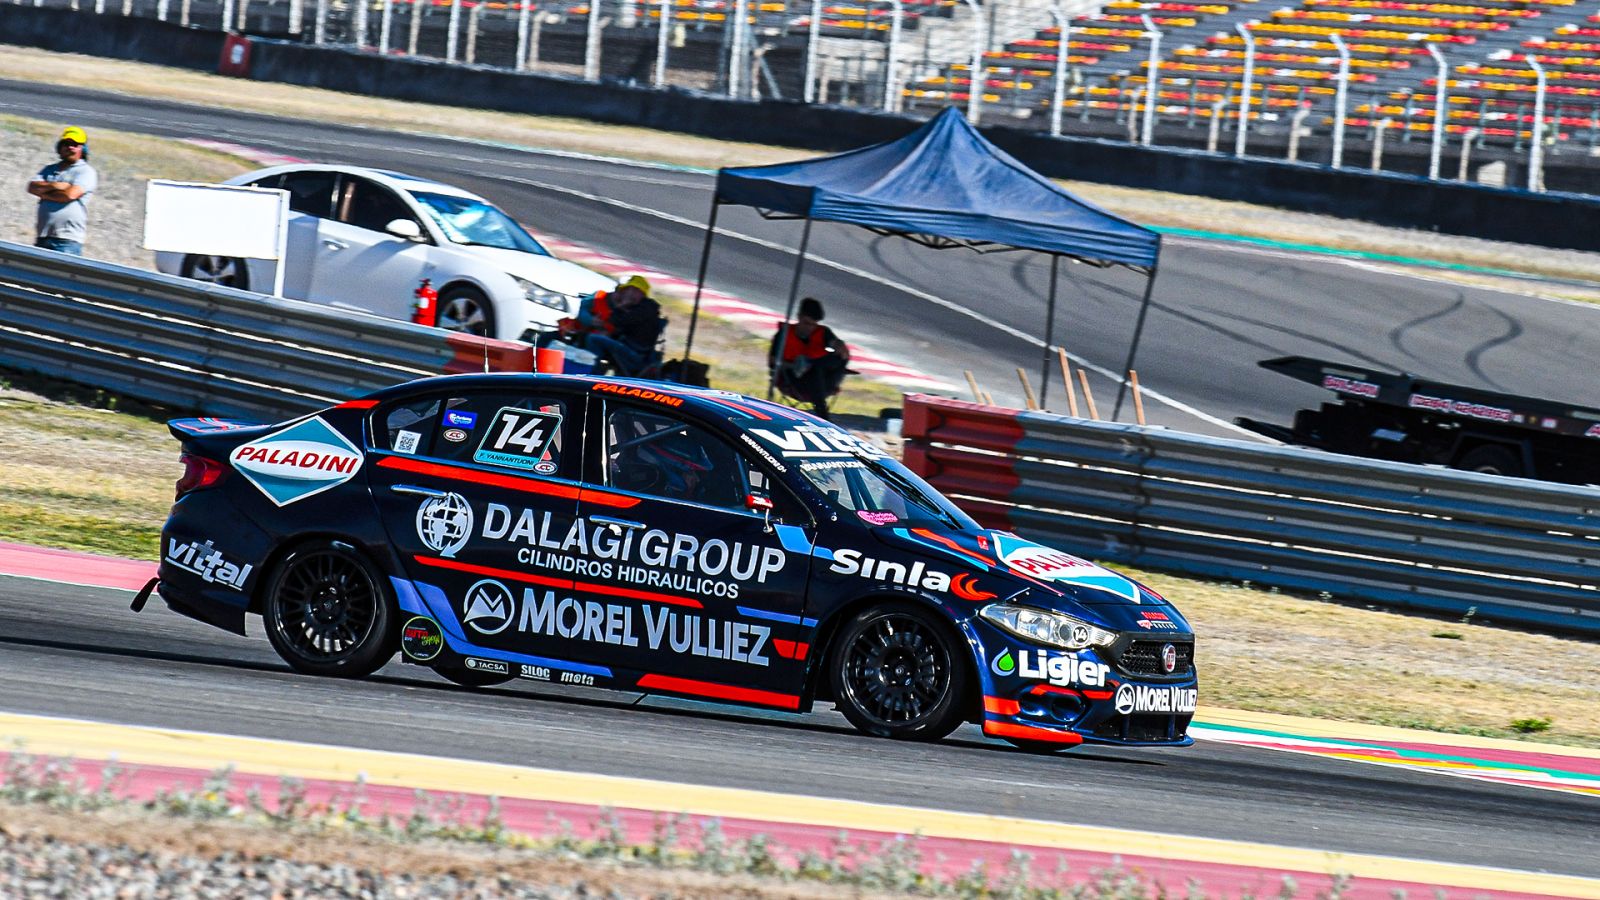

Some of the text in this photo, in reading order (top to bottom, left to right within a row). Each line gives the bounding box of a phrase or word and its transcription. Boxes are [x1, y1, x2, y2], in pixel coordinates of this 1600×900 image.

[592, 383, 684, 407] PALADINI
[494, 413, 543, 454] 14
[236, 447, 358, 474] PALADINI
[482, 502, 786, 584] DALAGI GROUP
[165, 538, 254, 592] vittal
[517, 547, 740, 600] CILINDROS HIDRAULICOS
[518, 587, 772, 667] MOREL VULLIEZ
[1074, 628, 1087, 641] 14
[478, 661, 505, 671] TACSA
[520, 665, 550, 679] SILOC
[1018, 649, 1111, 687] Ligier
[1135, 685, 1171, 712] MOREL
